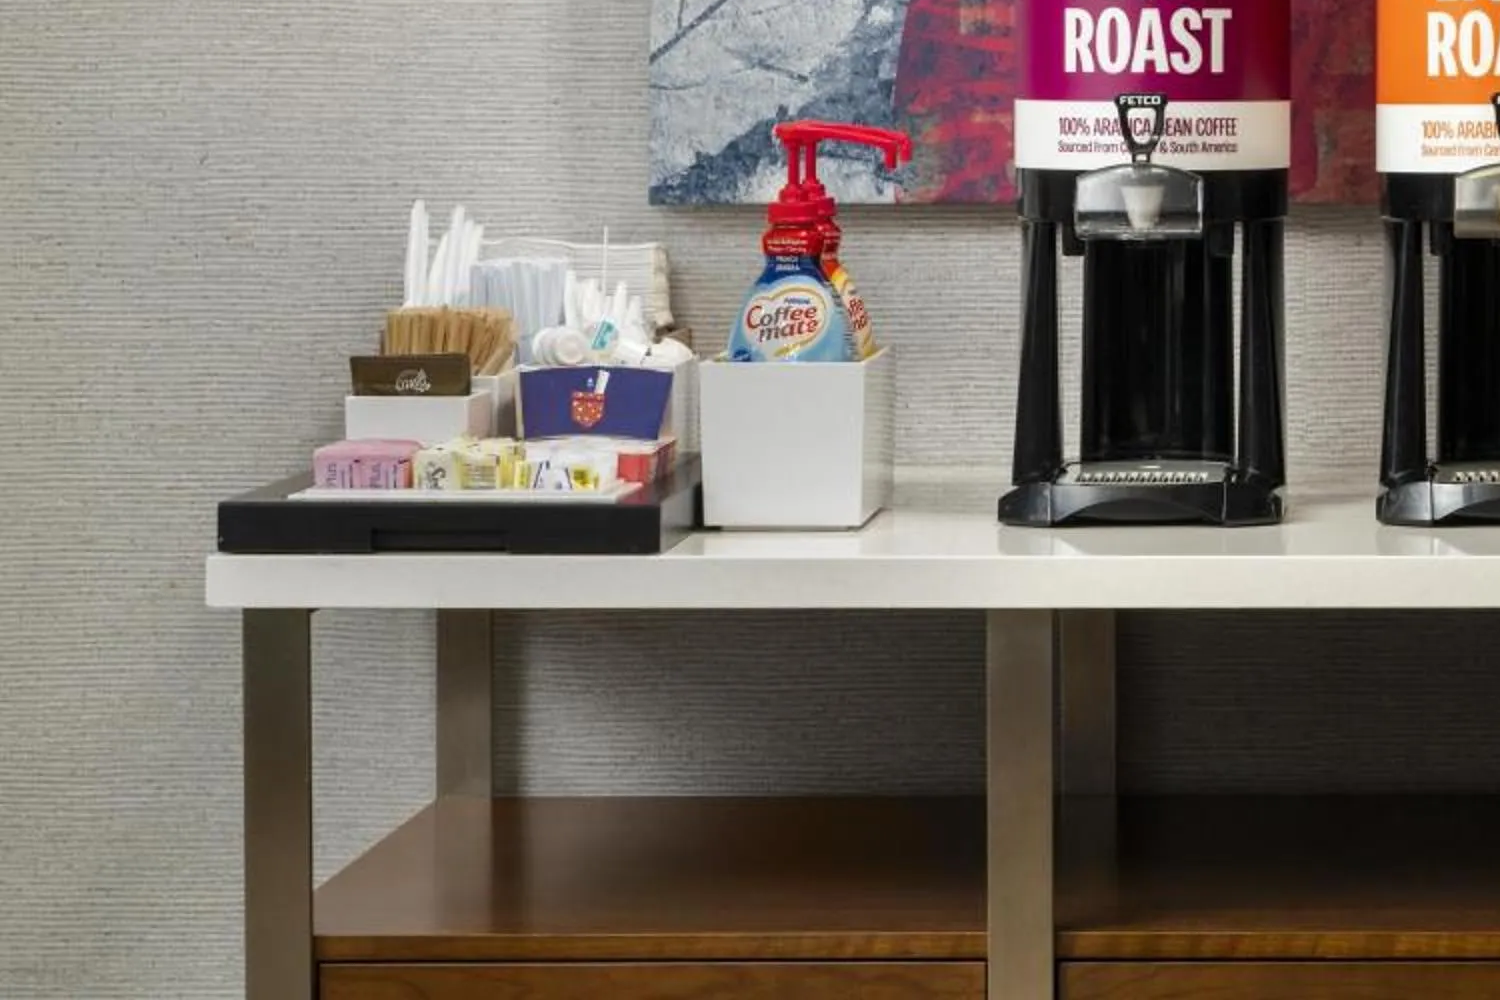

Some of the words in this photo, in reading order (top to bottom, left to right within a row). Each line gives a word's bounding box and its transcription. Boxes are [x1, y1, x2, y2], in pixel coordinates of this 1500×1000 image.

[1063, 6, 1233, 75] ROAST
[1119, 94, 1162, 106] FETCO
[1058, 116, 1091, 138] 100%
[1093, 116, 1151, 138] ARAICA
[1163, 116, 1193, 137] EAN
[1195, 116, 1238, 137] COFFEE
[1420, 119, 1454, 140] 100%
[746, 305, 818, 329] Coffee
[758, 319, 819, 343] mate
